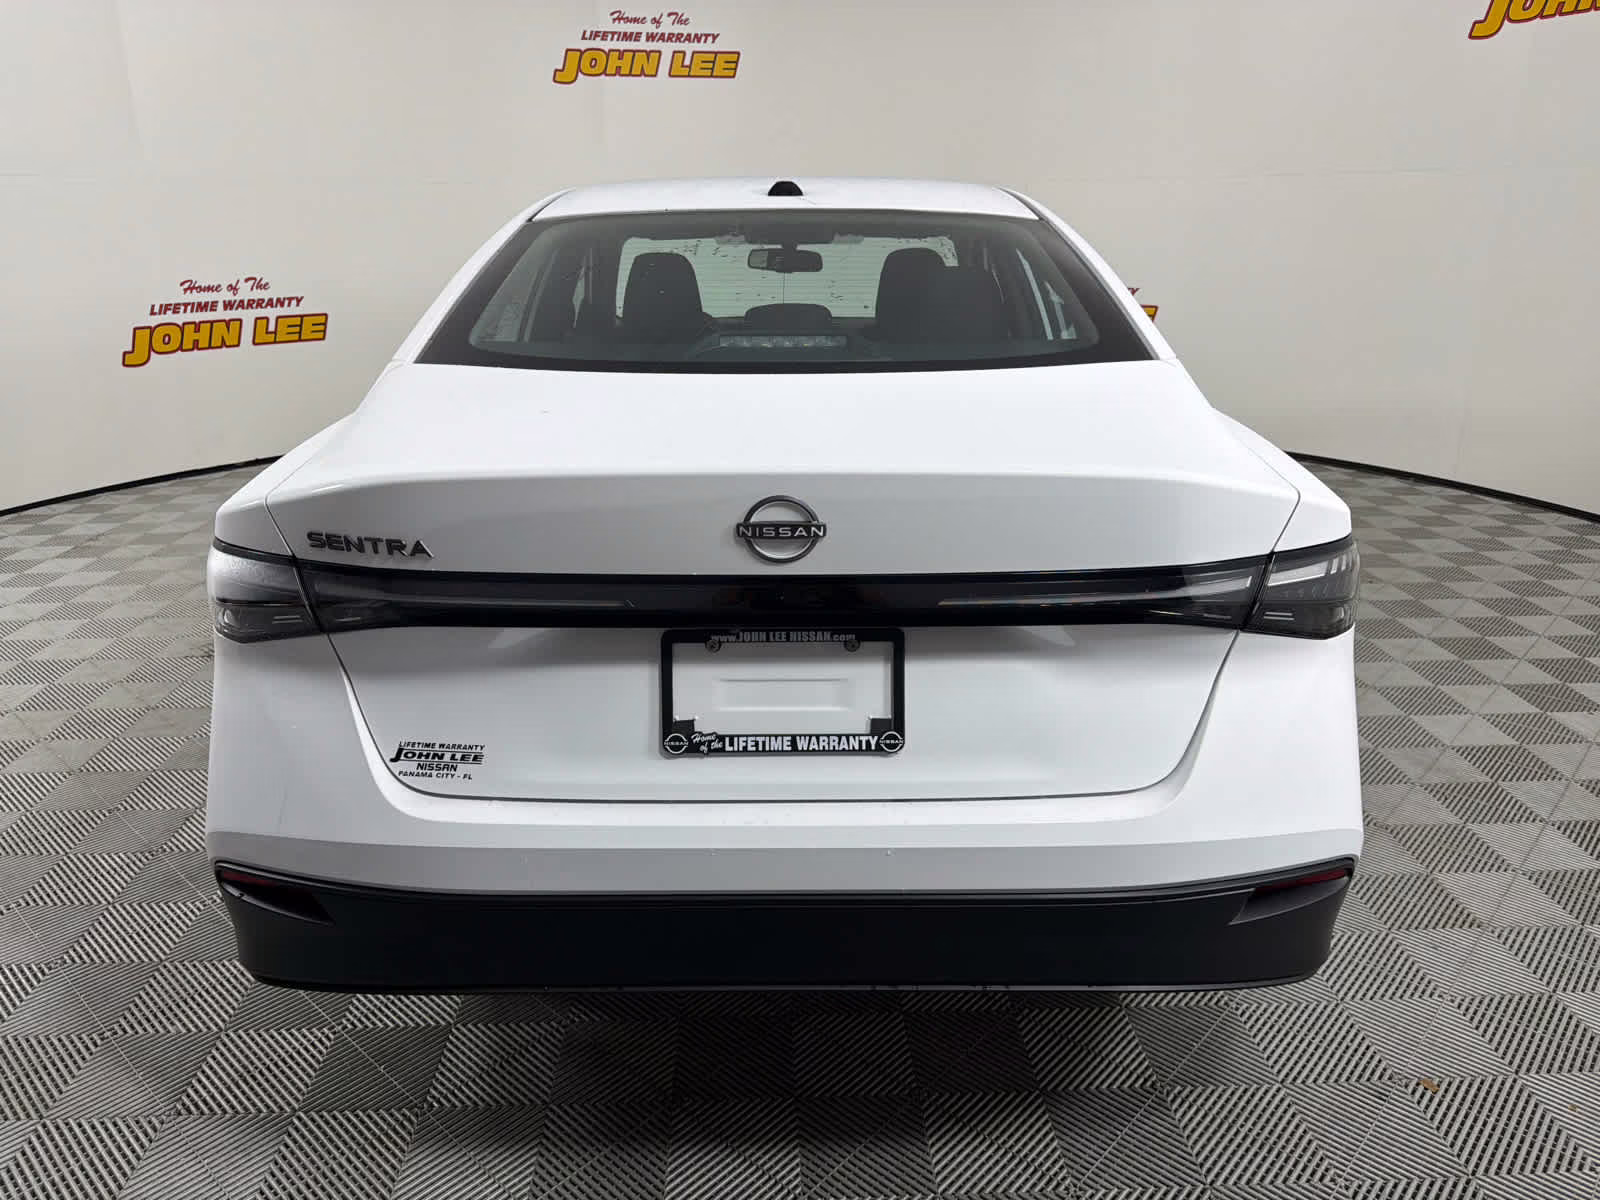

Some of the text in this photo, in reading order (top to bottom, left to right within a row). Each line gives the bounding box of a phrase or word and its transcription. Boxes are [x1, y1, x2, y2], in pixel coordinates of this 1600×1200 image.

[609, 10, 690, 29] Home of The
[581, 30, 720, 44] LIFETIME WARRANTY
[553, 48, 741, 84] JOHN LEE
[180, 277, 270, 296] Home of The
[149, 296, 304, 316] LIFETIME WARRANTY
[122, 313, 328, 367] JOHN LEE
[740, 526, 824, 537] NISSAN
[307, 531, 434, 558] SENTRA
[769, 631, 787, 642] LEE
[691, 733, 716, 744] Home
[725, 735, 878, 751] LIFETIME WARRANTY
[399, 741, 485, 751] LIFETIME WARRANTY
[700, 739, 723, 754] of the
[390, 748, 484, 762] JOHN LEE
[398, 770, 433, 778] PANAMA
[416, 762, 458, 772] NISSAN
